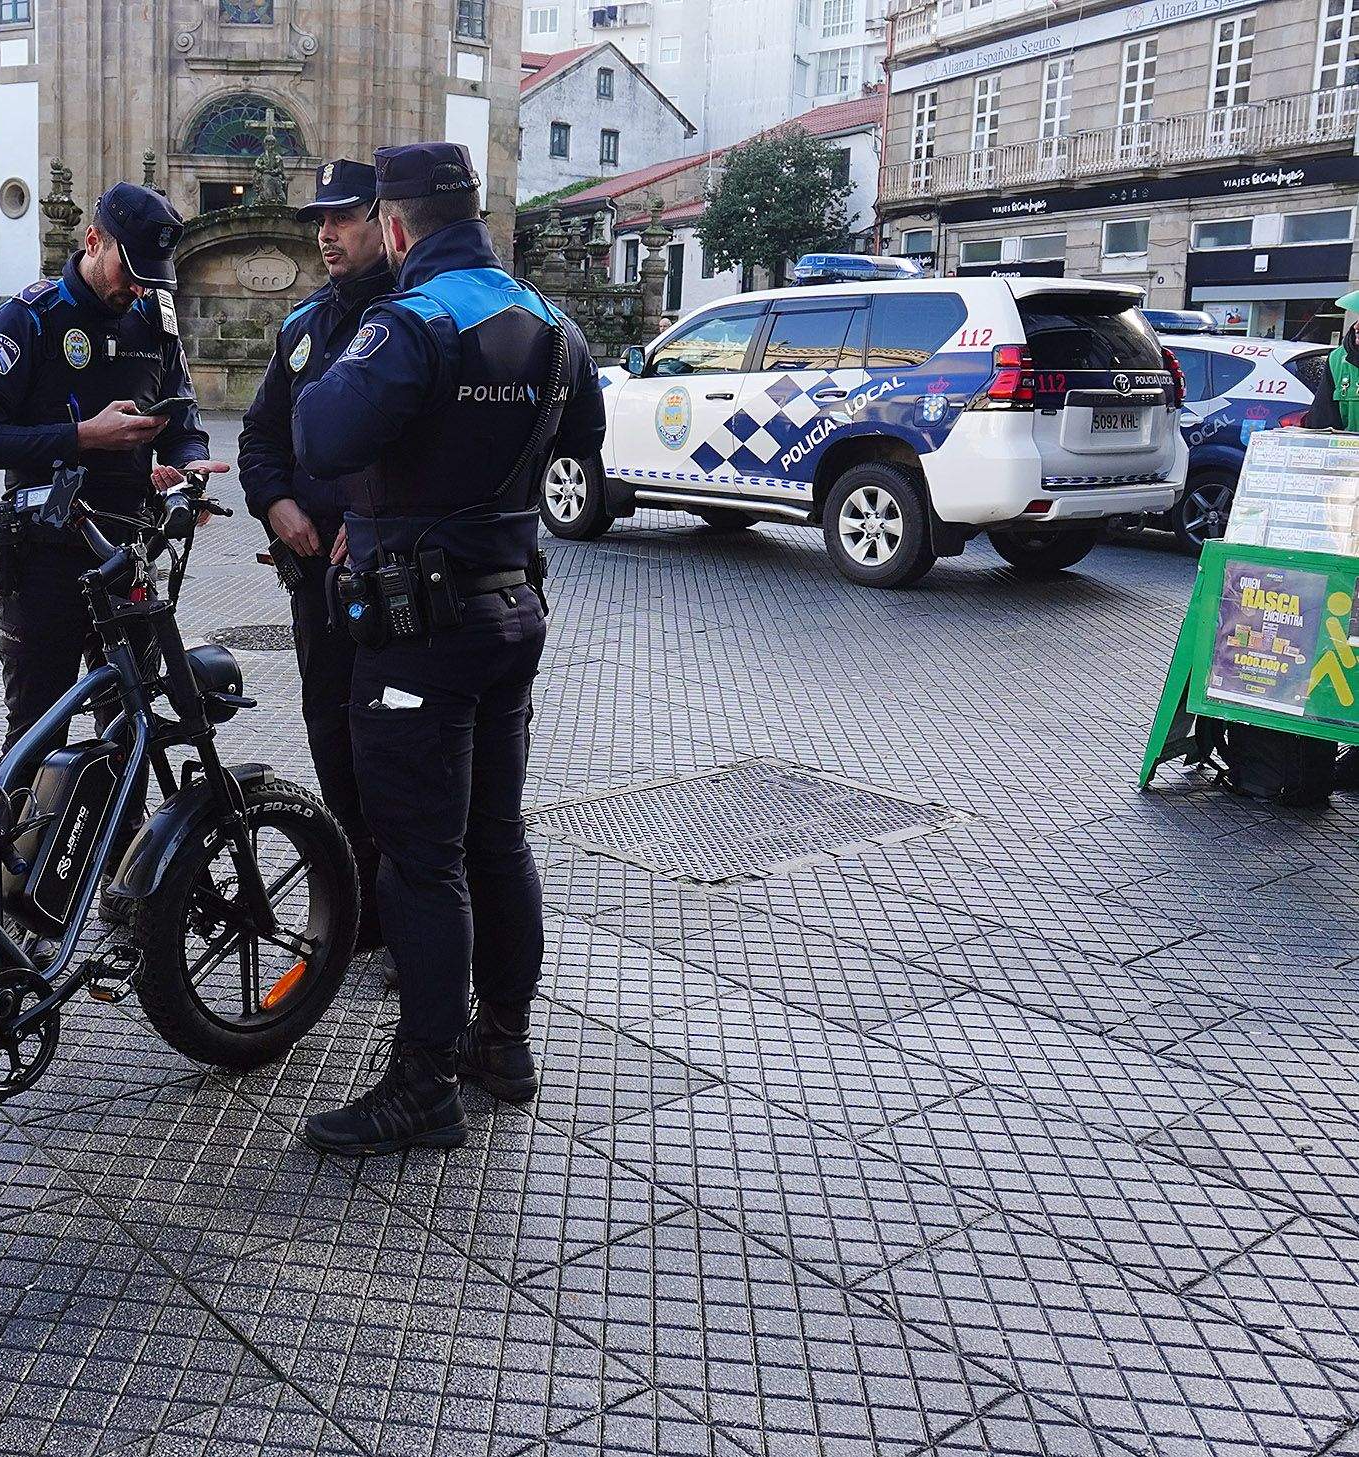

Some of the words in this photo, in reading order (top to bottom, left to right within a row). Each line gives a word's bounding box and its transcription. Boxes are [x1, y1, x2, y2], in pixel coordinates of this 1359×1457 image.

[1149, 2, 1198, 24] Alianza
[941, 56, 974, 76] Alianza
[976, 45, 1018, 69] Española
[1020, 34, 1061, 56] Seguros
[1224, 177, 1250, 188] VIAJES
[957, 328, 993, 347] 112
[1231, 344, 1273, 358] 092
[457, 381, 526, 402] POLICÍA
[1038, 373, 1067, 393] 112
[1255, 379, 1288, 395] 112
[844, 376, 906, 417] LOCAL
[1094, 414, 1119, 429] 5092
[1121, 413, 1139, 429] KHL
[1188, 413, 1236, 446] OCAL
[780, 416, 842, 473] POLICÍA
[1239, 576, 1261, 590] QUIEN
[1241, 587, 1300, 616] RASCA
[1263, 610, 1303, 628] ENCUENTRA
[262, 801, 315, 819] 20x4.0
